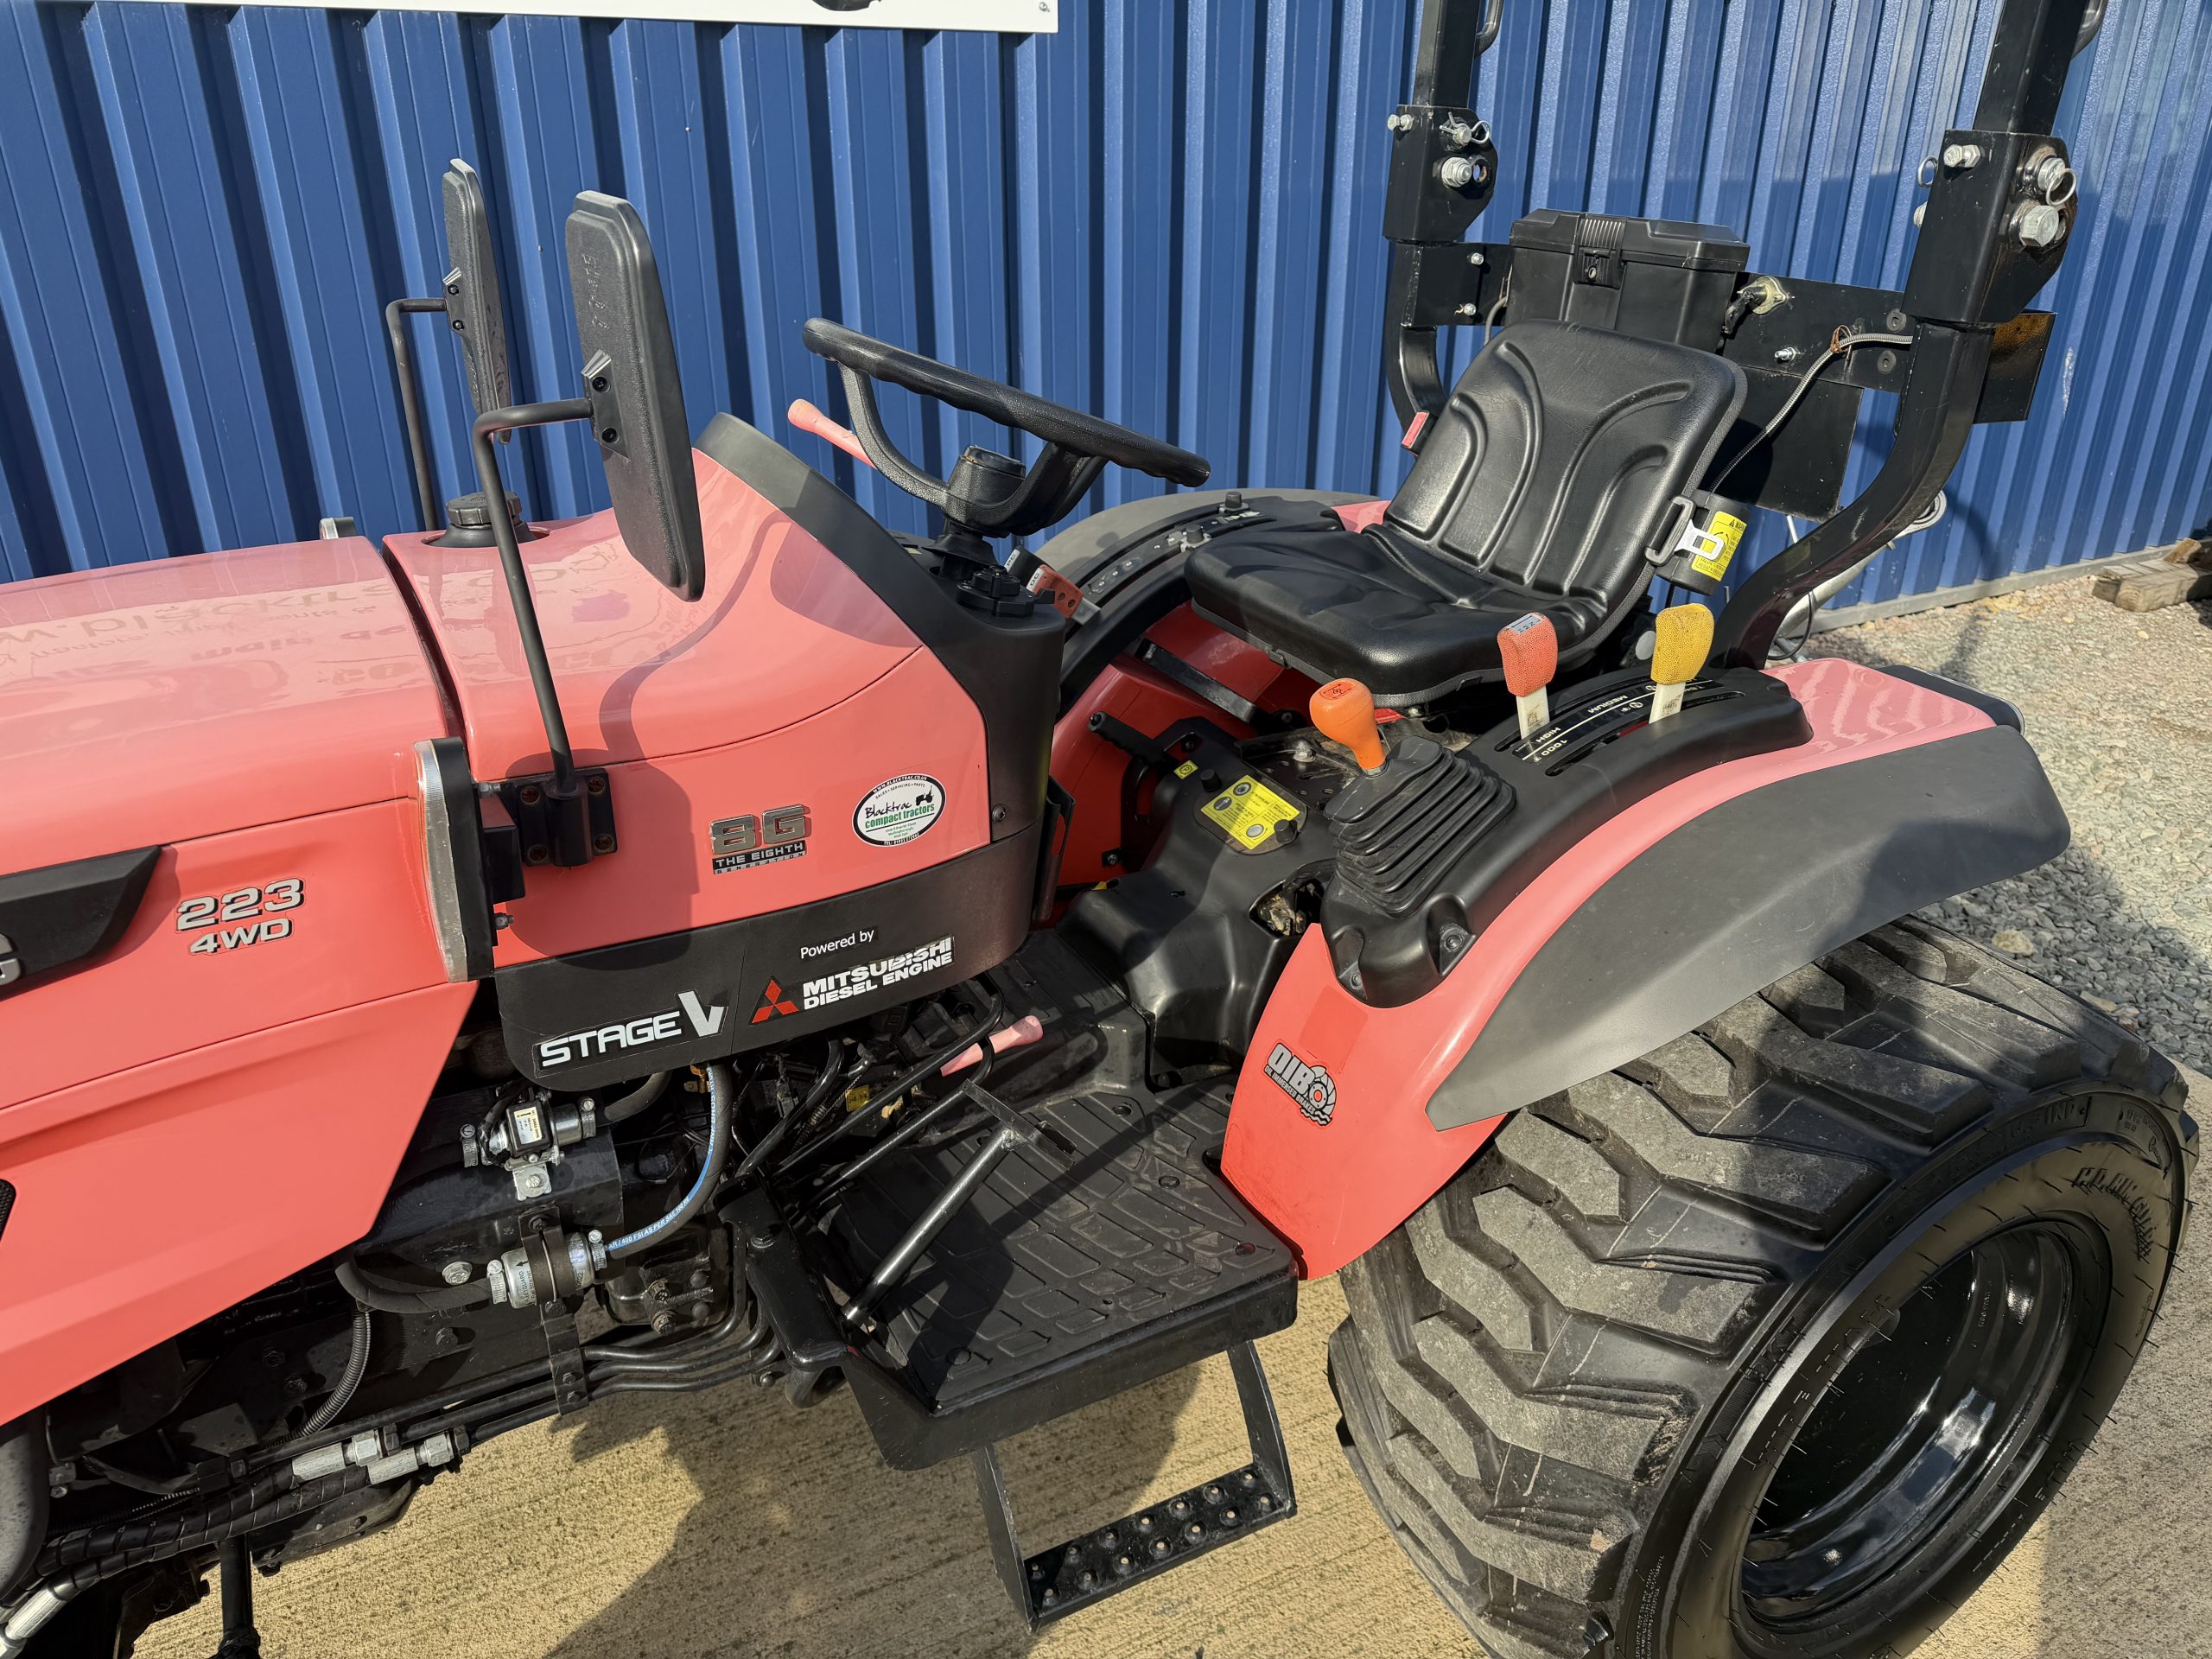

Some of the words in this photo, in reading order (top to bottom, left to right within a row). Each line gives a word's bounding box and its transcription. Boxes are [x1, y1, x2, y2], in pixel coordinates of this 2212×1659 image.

[1587, 695, 1629, 714] MEDIUM
[1535, 727, 1561, 743] HIGH
[1541, 739, 1567, 756] 1000
[890, 782, 911, 791] SERVICING
[865, 801, 912, 819] Blacktrac
[865, 813, 902, 829] compact
[903, 804, 935, 819] tractors
[709, 804, 805, 855] 8G
[715, 855, 746, 868] THE
[752, 842, 804, 861] EIGHTH
[716, 852, 804, 874] GENERATION
[177, 878, 305, 931] 223
[189, 917, 293, 953] 4WD
[800, 933, 855, 959] Powered
[859, 930, 874, 943] by
[803, 937, 952, 998] MITSUBISHI
[804, 979, 878, 1010] DIESEL
[882, 951, 953, 986] ENGINE
[540, 1011, 682, 1067] STAGE
[678, 990, 725, 1037] V
[1272, 1071, 1298, 1097] IMMERSED
[1296, 1094, 1315, 1115] BRAKES
[621, 1235, 632, 1244] 400
[643, 1227, 654, 1238] AS
[654, 1219, 665, 1231] PER
